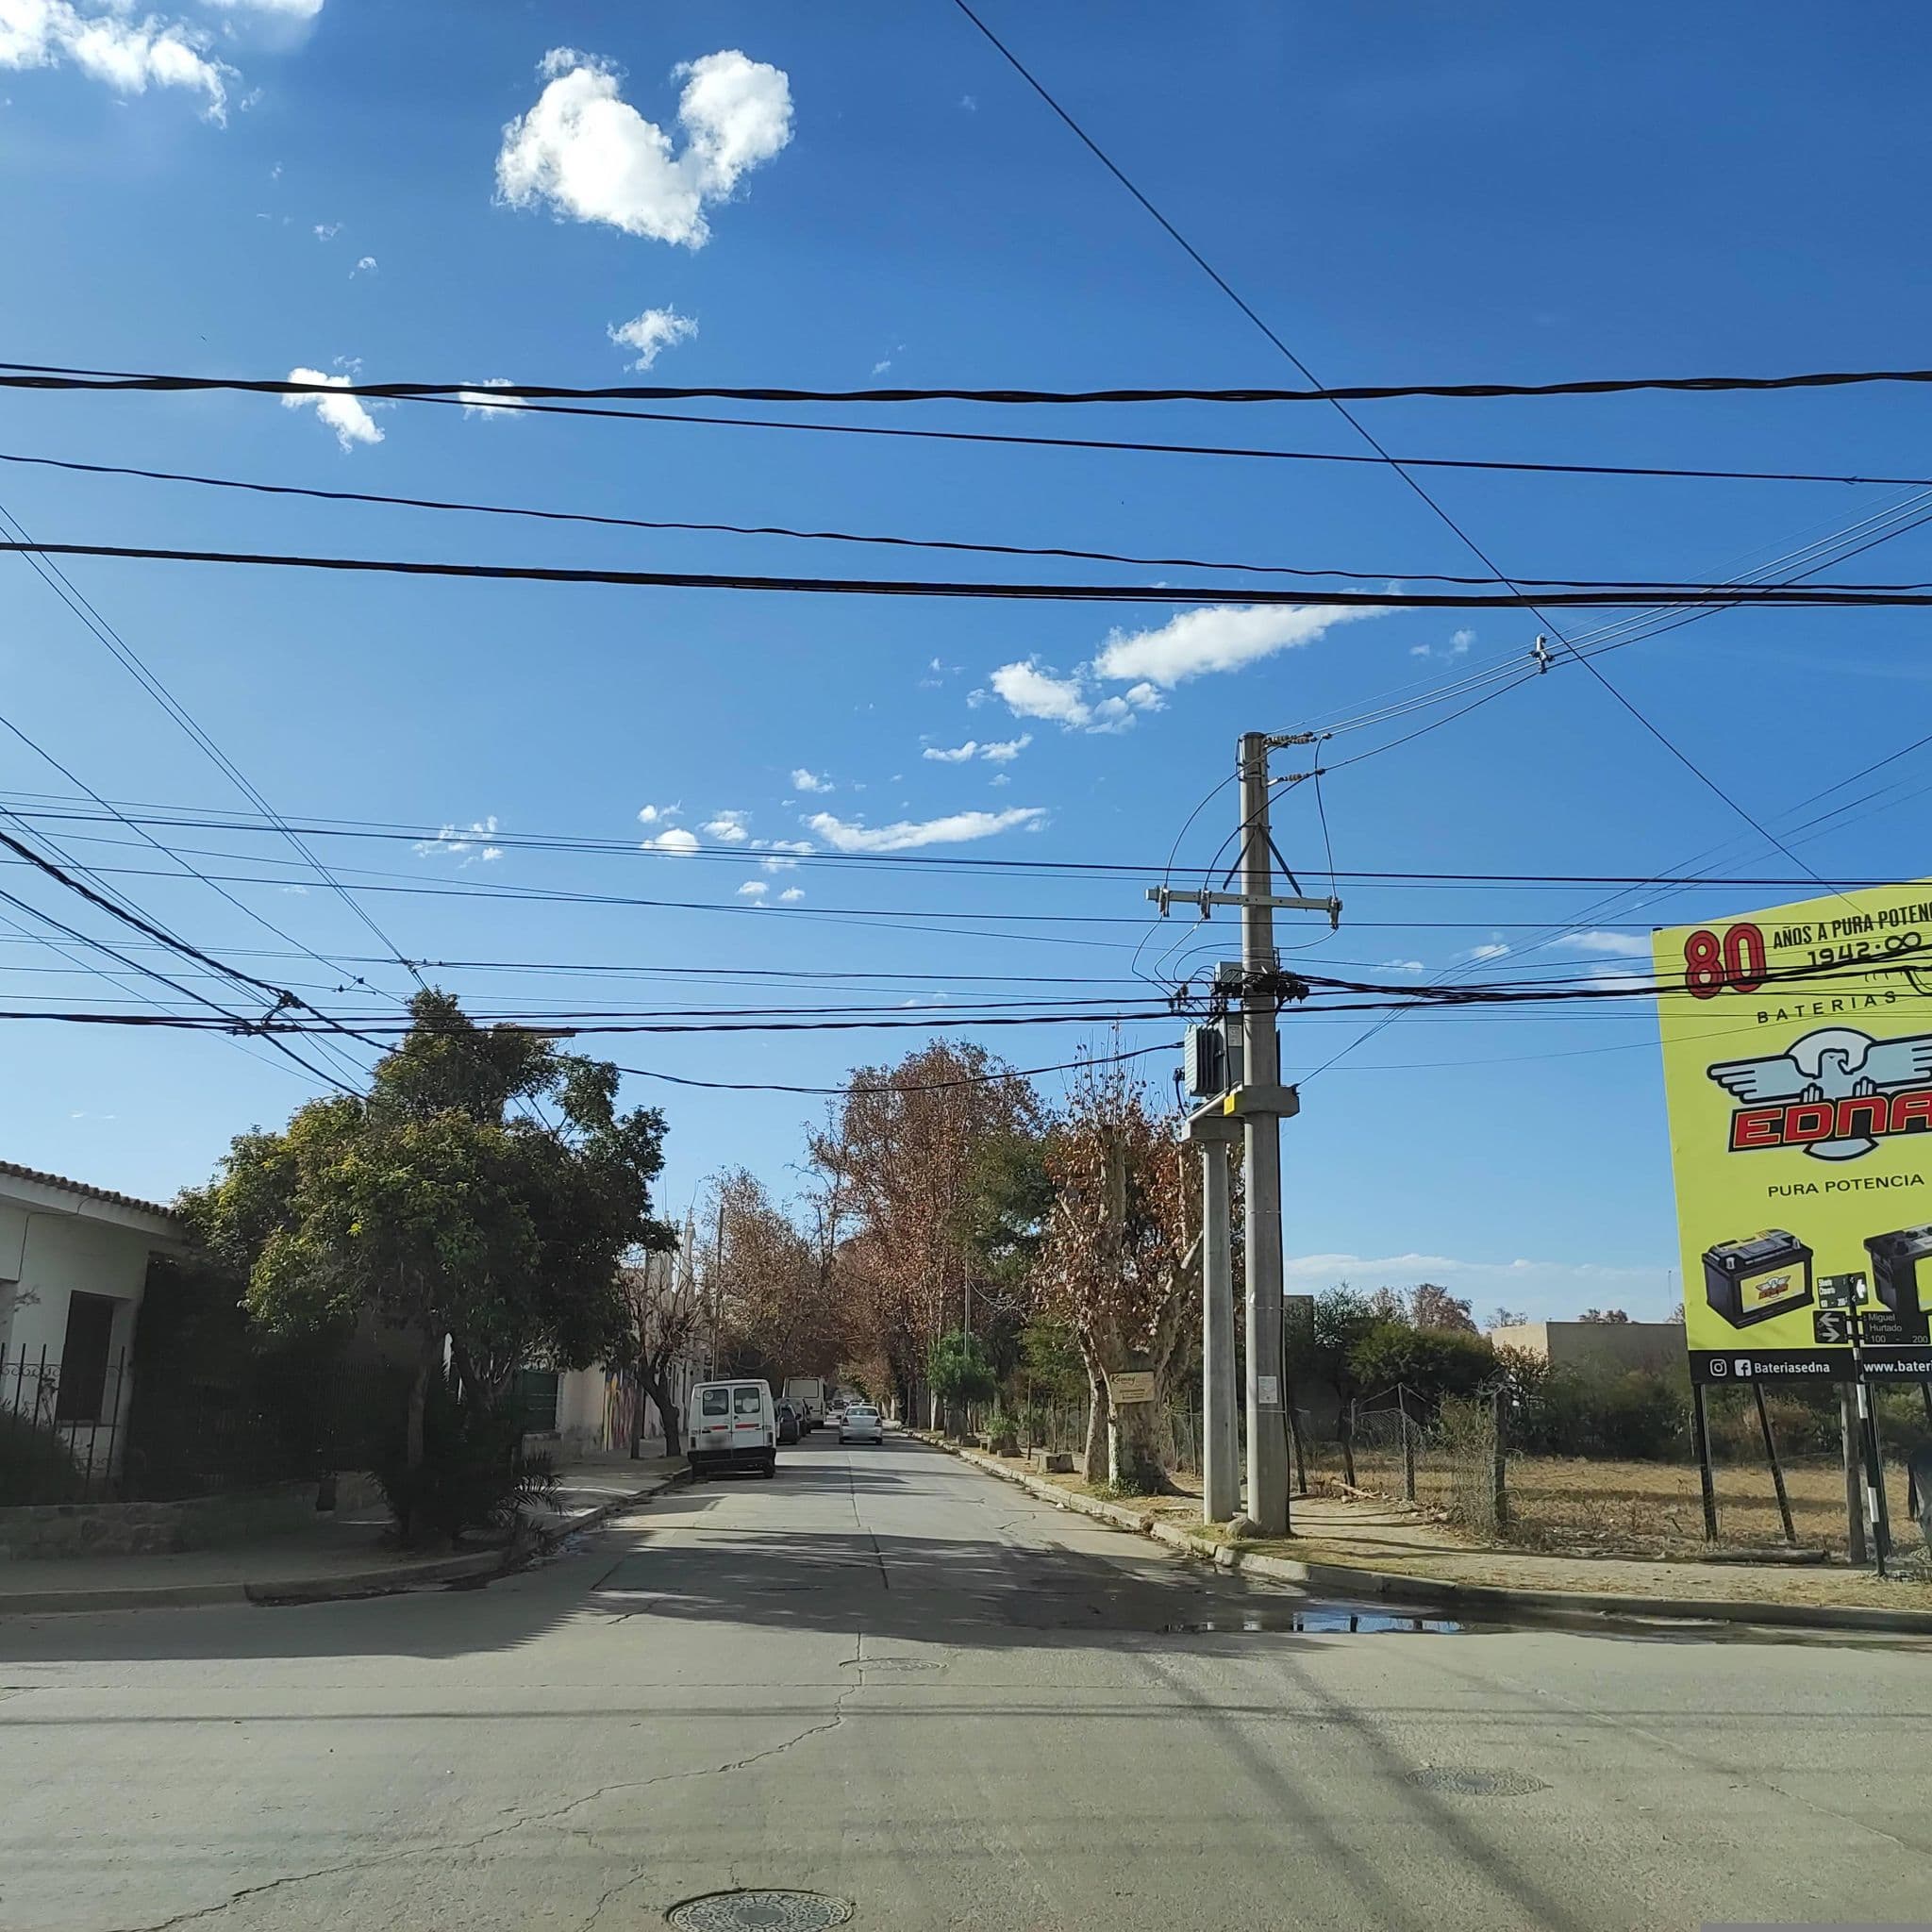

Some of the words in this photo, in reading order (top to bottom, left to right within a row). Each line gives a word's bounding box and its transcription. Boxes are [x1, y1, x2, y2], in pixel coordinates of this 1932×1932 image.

[1774, 926, 1812, 949] AÑOS
[1818, 923, 1828, 941] A
[1832, 913, 1874, 938] PURA
[1684, 923, 1767, 1000] 80
[1757, 991, 1896, 1024] BATERIAS
[1731, 1089, 1932, 1150] EDNA
[1768, 1183, 1819, 1197] PURA
[1825, 1174, 1924, 1193] POTENCIA
[1868, 1313, 1895, 1323] Miguel
[1912, 1335, 1928, 1343] 200
[1755, 1361, 1830, 1374] Bateriasedna
